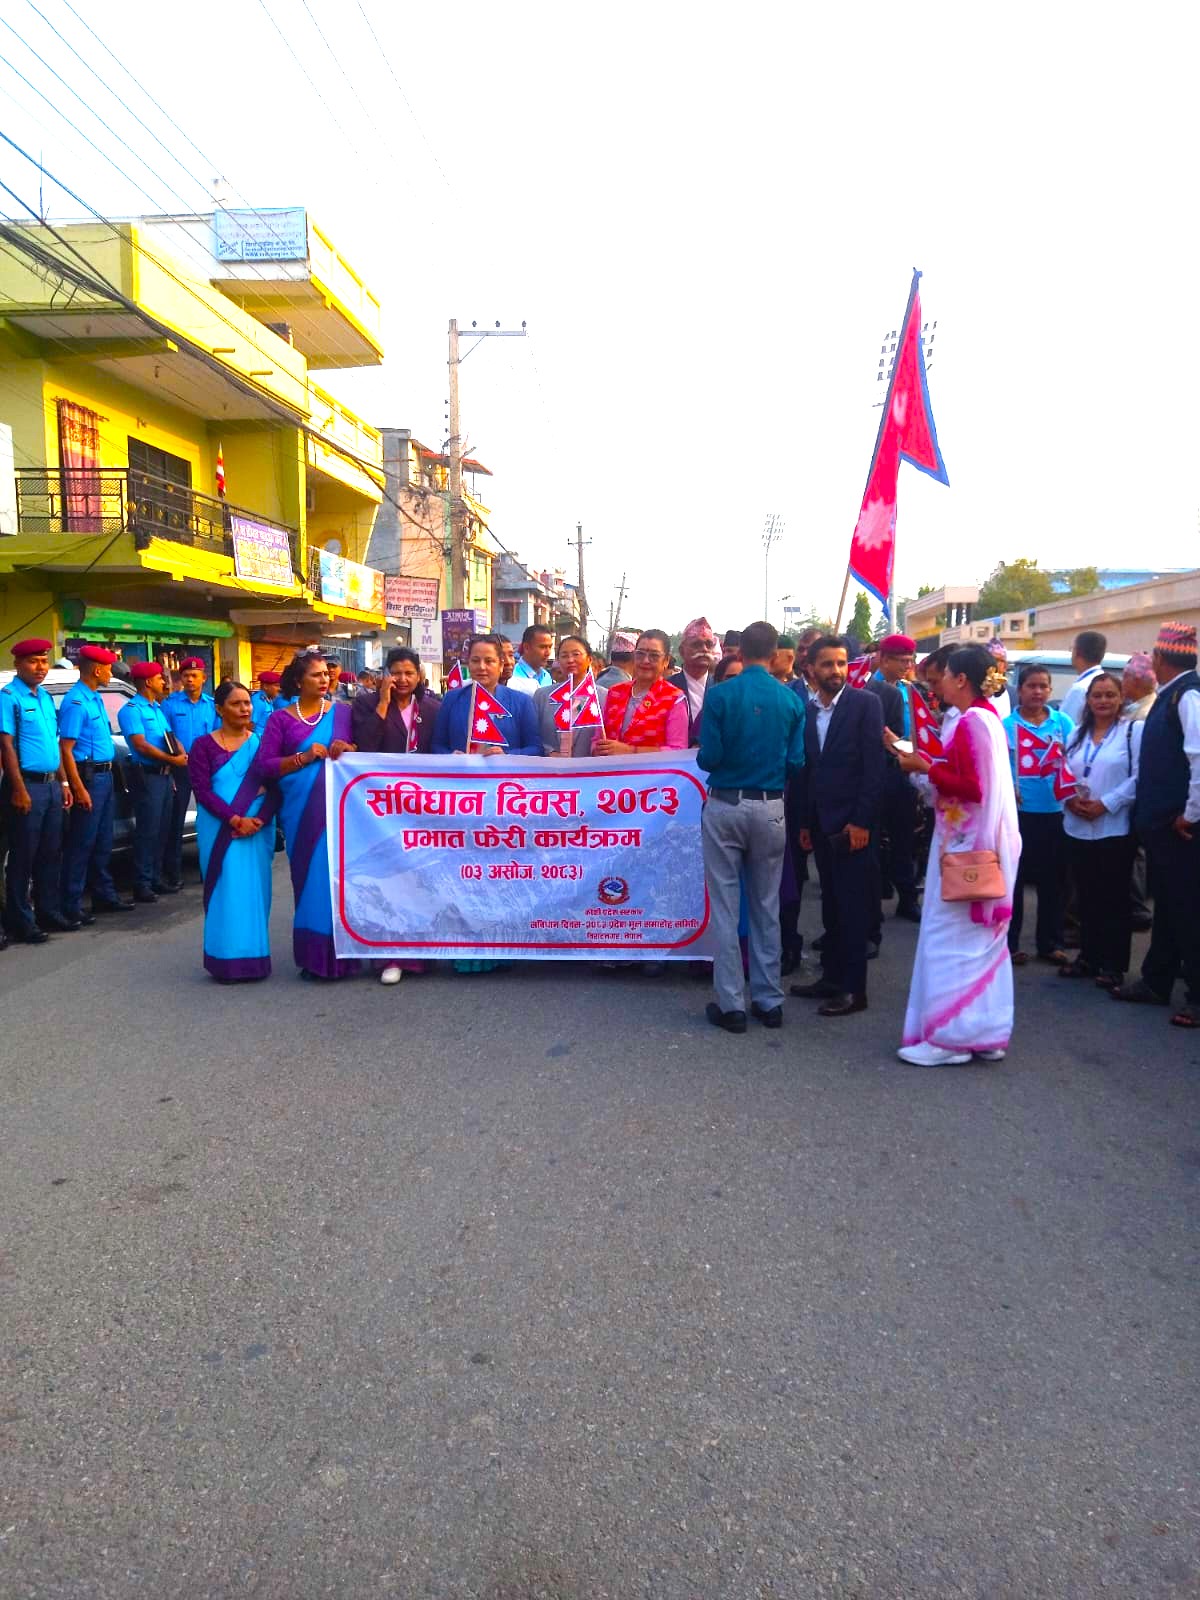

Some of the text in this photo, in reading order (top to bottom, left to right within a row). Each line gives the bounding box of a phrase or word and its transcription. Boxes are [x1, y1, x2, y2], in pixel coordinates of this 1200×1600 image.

[365, 780, 680, 818] संविधान दिवस, २०८३
[402, 825, 642, 850] प्रभात फेरी कार्यक्रम
[460, 861, 583, 881] (०३ असोज, २०८३)
[643, 919, 673, 929] समारोह
